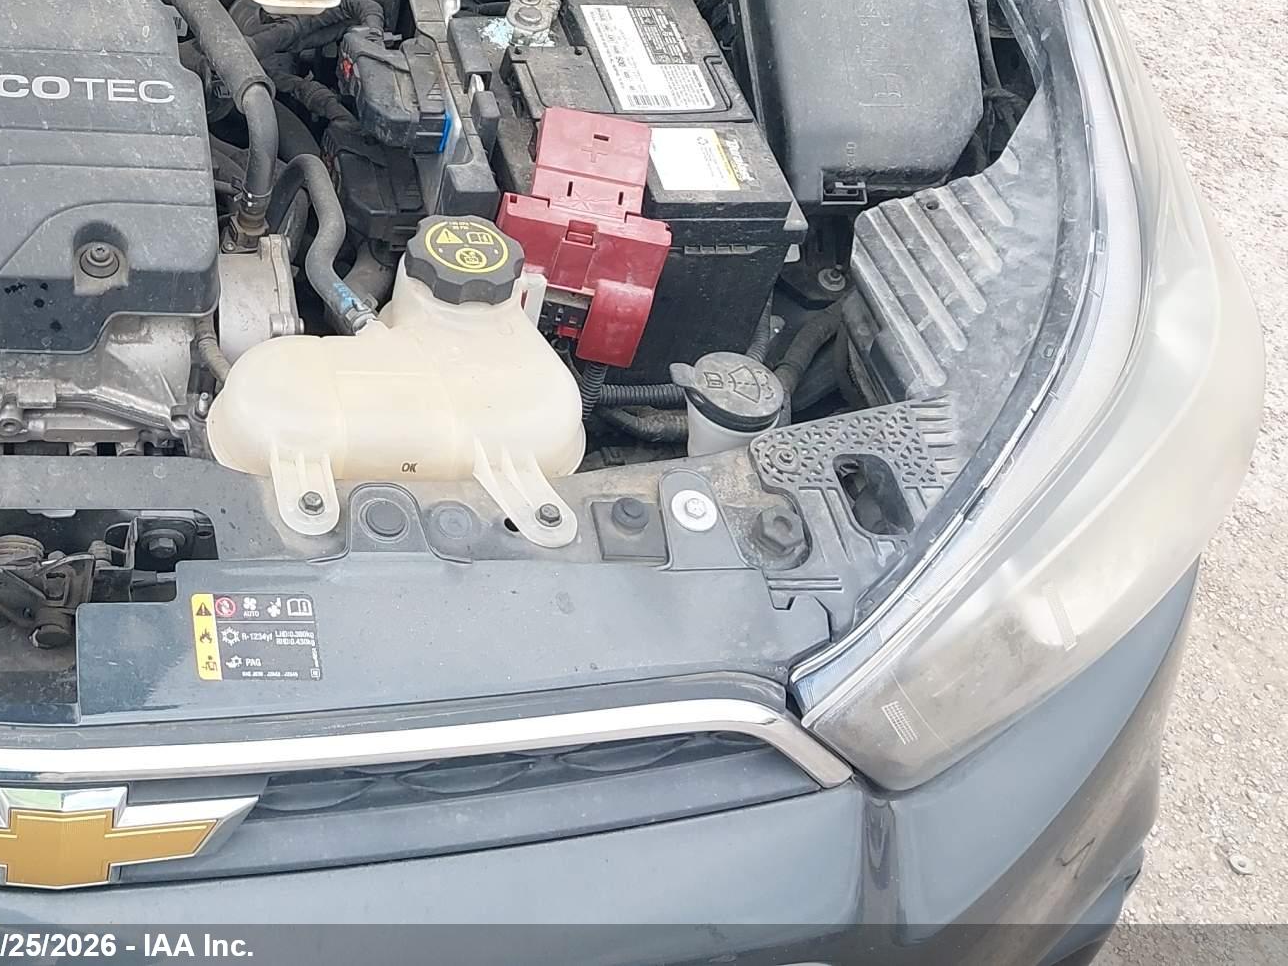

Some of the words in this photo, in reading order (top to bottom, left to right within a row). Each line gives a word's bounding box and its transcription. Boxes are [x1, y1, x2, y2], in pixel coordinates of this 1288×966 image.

[401, 462, 418, 473] OK
[243, 610, 260, 618] AUTO
[245, 658, 262, 667] PAG
